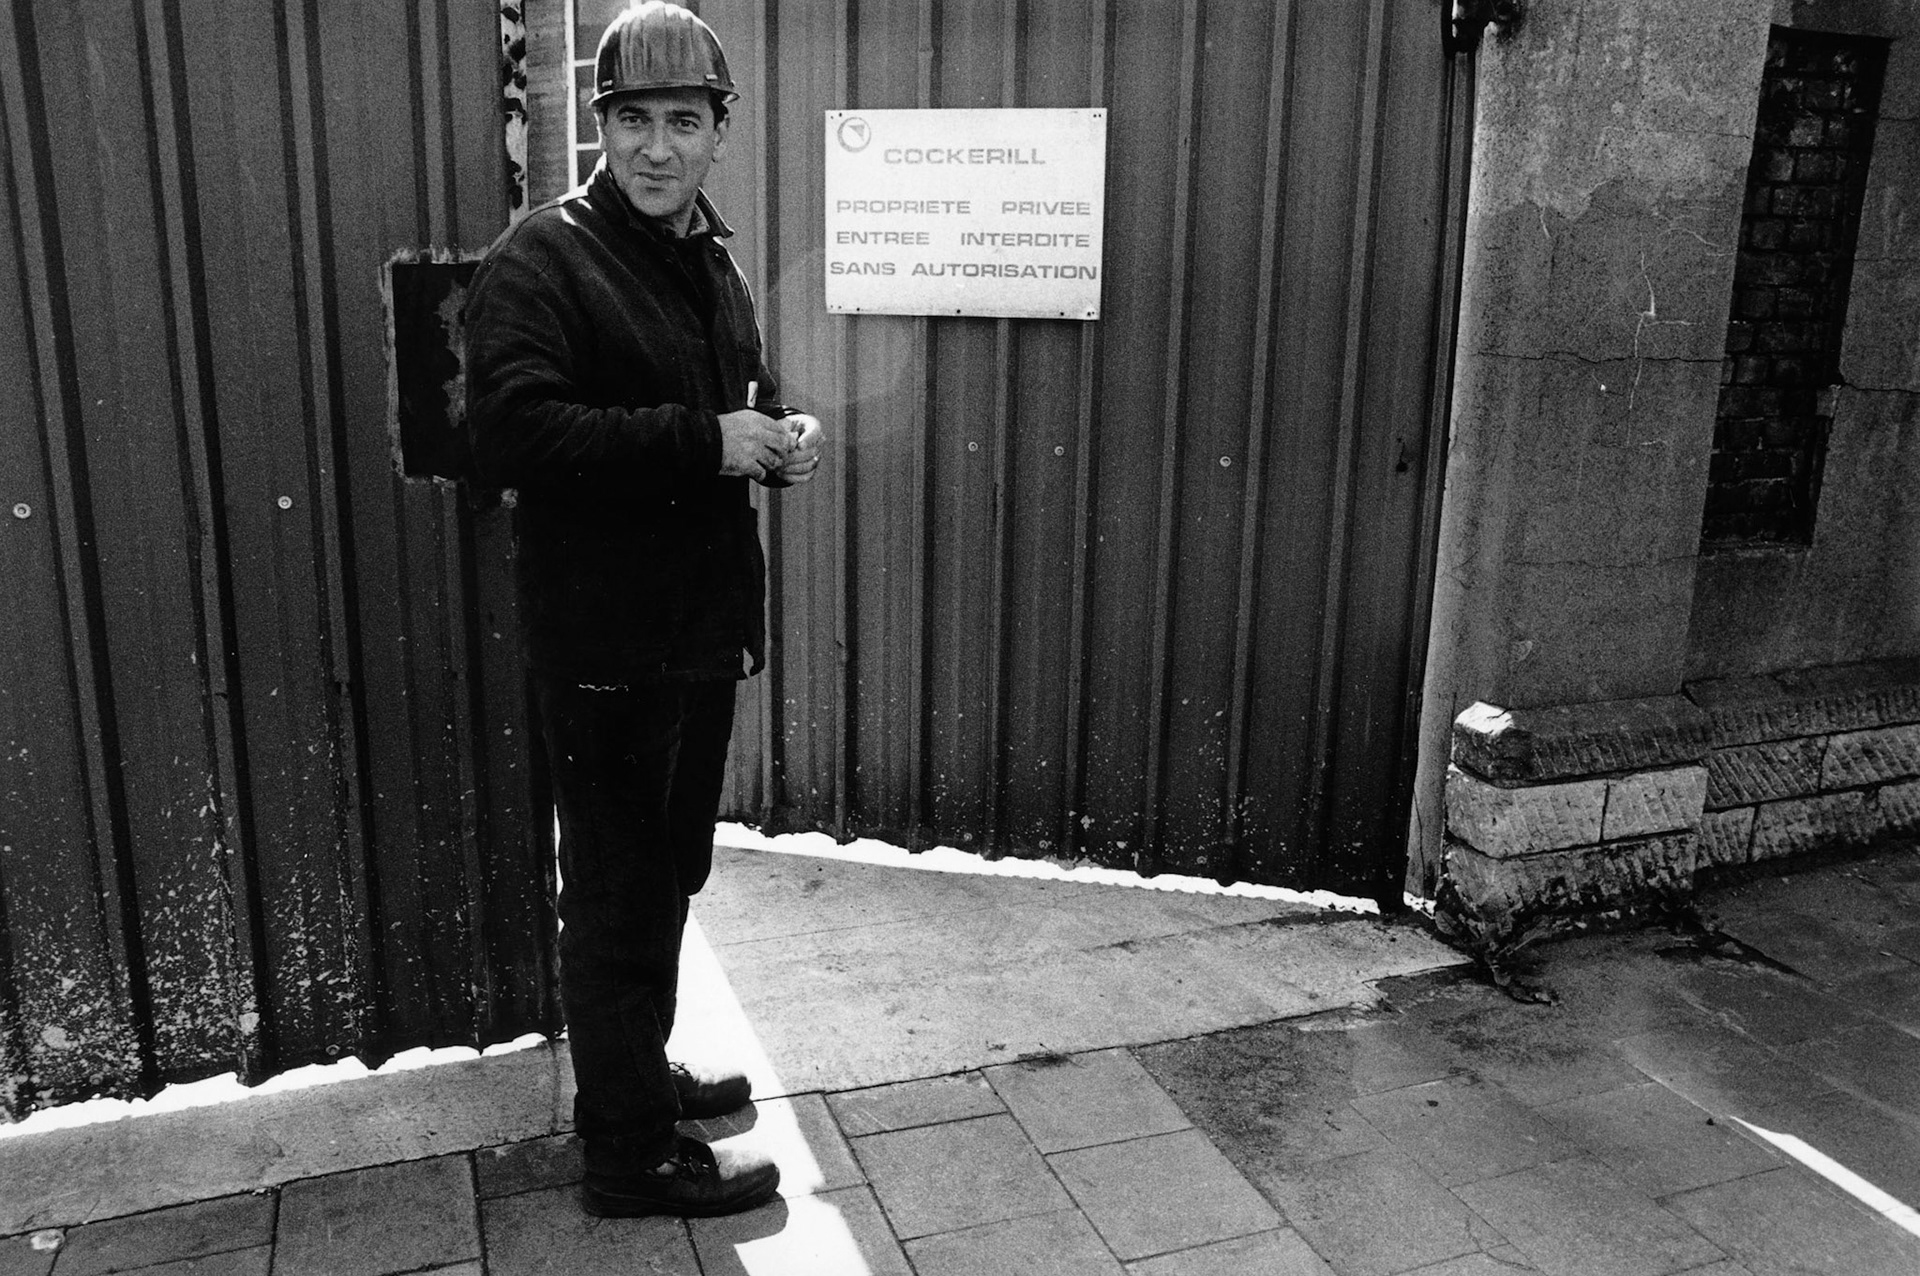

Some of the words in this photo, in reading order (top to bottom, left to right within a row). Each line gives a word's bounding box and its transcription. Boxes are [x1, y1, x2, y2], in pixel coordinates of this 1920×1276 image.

[883, 148, 1046, 165] COCKERILL
[836, 200, 972, 215] PROPRIETE
[1001, 201, 1091, 216] PRIVEE
[836, 231, 930, 245] ENTREE
[960, 232, 1090, 248] INTERDITE
[830, 261, 896, 276] SANS
[911, 263, 1097, 280] AUTORISATION
